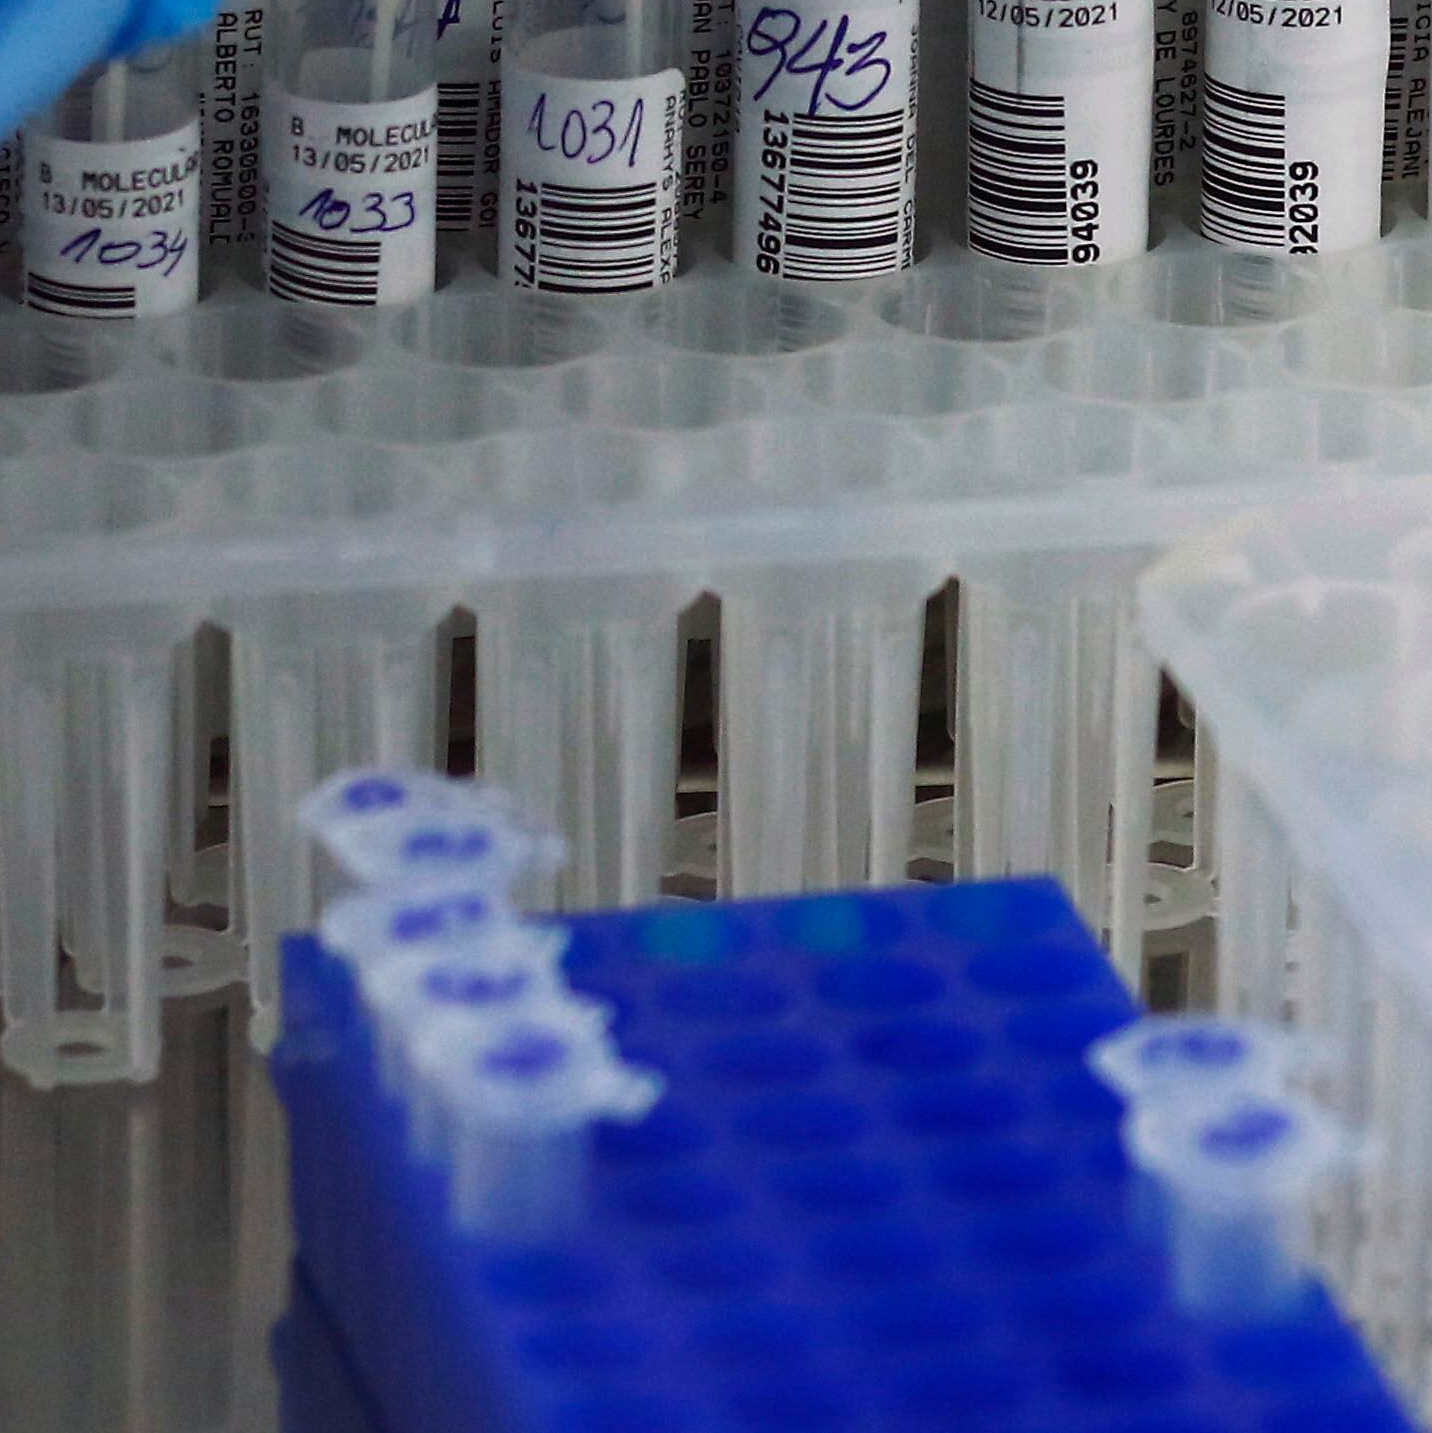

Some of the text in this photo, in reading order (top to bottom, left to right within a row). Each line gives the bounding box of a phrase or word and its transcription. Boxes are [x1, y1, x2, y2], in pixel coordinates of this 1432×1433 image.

[214, 12, 239, 124] ALBERTO
[747, 7, 891, 116] 943
[1155, 31, 1177, 61] DE
[687, 49, 712, 129] PABLO
[292, 146, 430, 174] 13/05/2021
[528, 91, 643, 168] 1031
[1153, 76, 1176, 188] LOURDES
[42, 189, 184, 219] 13/05/2021
[81, 151, 199, 192] MOLECULA
[682, 145, 707, 220] SEREY
[756, 109, 790, 274] 13677496
[299, 188, 416, 233] 1033
[514, 178, 539, 289] 13677
[900, 199, 913, 271] CARM
[1069, 159, 1100, 264] 94039
[60, 226, 188, 278] 1034
